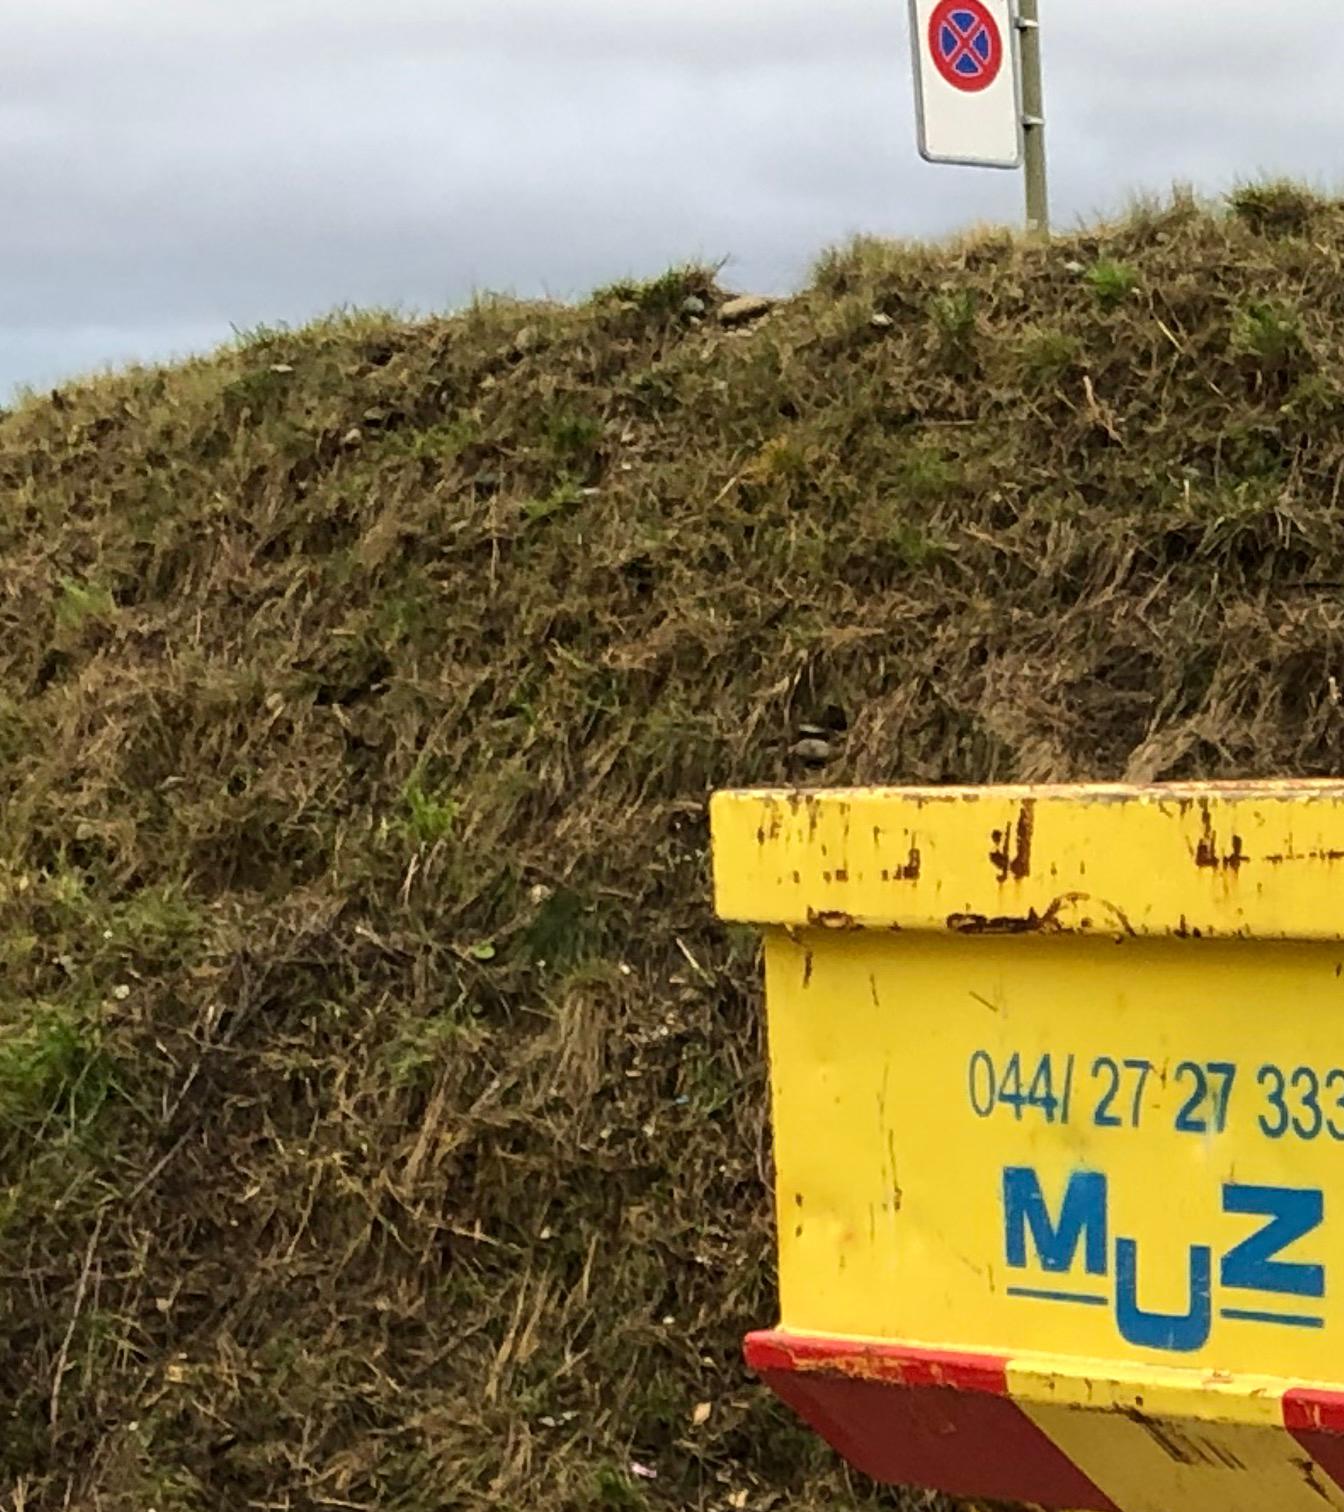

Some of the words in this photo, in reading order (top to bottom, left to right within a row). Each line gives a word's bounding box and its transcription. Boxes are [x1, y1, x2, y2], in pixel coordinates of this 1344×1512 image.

[968, 1050, 1075, 1124] 044/
[1091, 1057, 1150, 1128] 27
[1174, 1062, 1236, 1133] 27
[1002, 1166, 1326, 1352] MUZ
